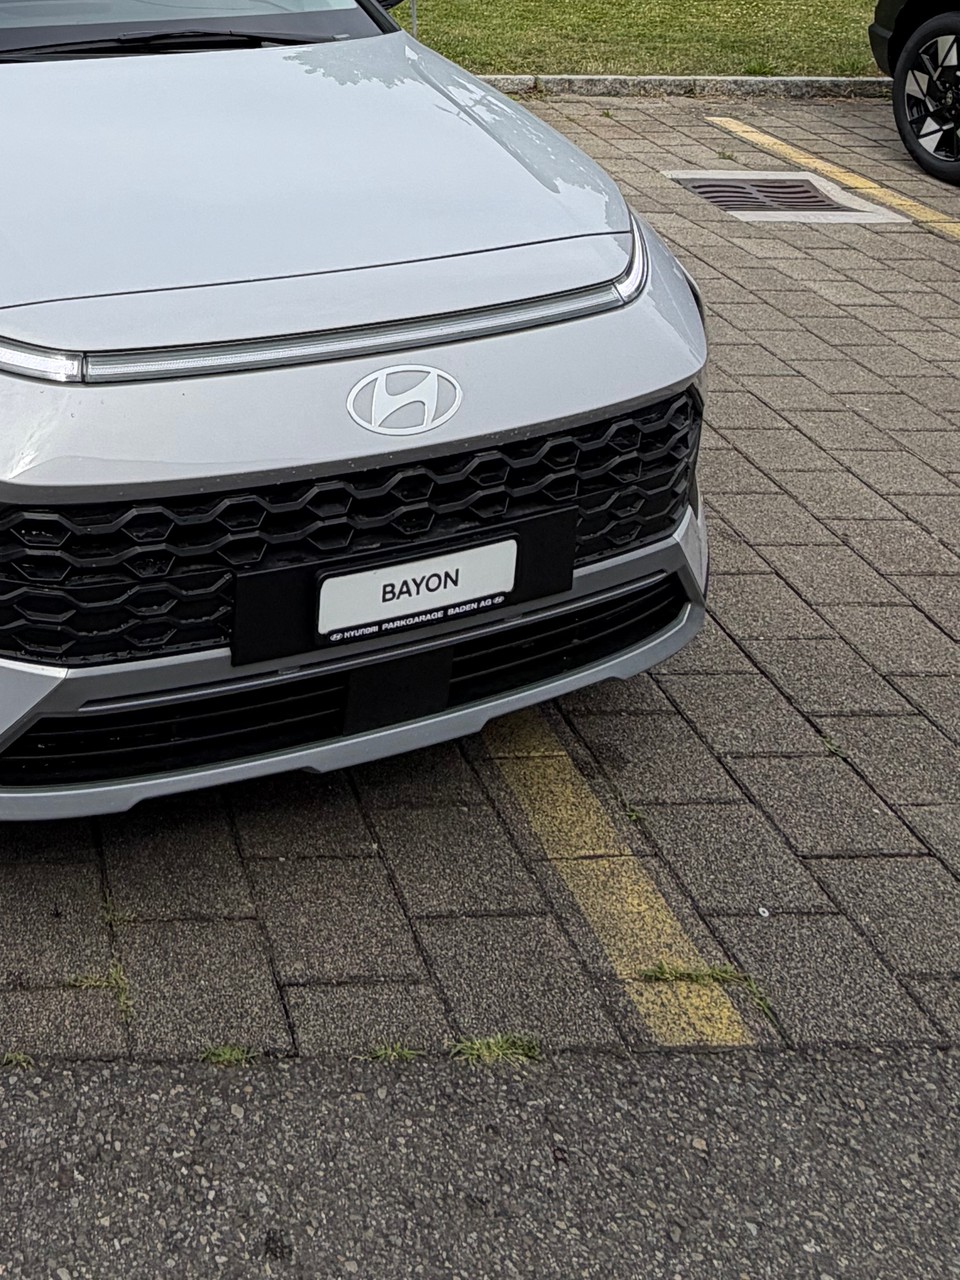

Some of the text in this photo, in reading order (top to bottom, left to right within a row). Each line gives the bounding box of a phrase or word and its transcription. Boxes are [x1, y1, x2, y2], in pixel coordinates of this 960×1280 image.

[381, 568, 460, 604] BAYON
[344, 598, 492, 639] HYUNDAI PARKGARAGE BADEN AG
